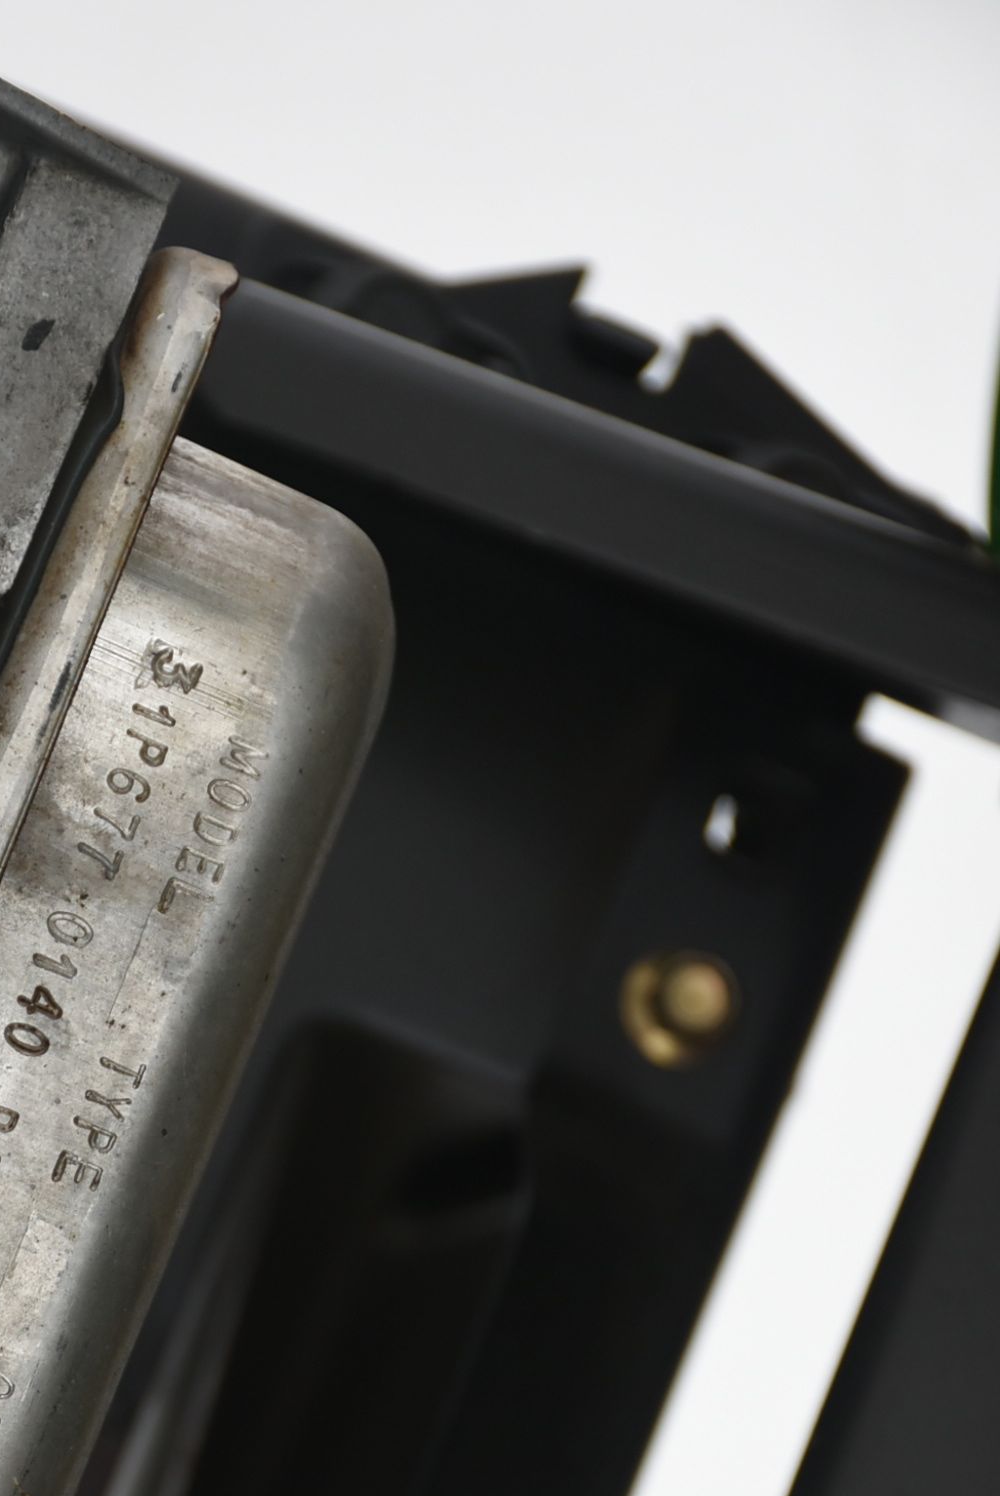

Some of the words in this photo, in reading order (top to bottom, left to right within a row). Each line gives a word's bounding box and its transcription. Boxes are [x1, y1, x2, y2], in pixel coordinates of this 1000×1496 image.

[76, 645, 202, 880] 31P677
[157, 735, 268, 911] MODEL
[3, 911, 93, 1056] 0140
[50, 1057, 145, 1191] TYPE
